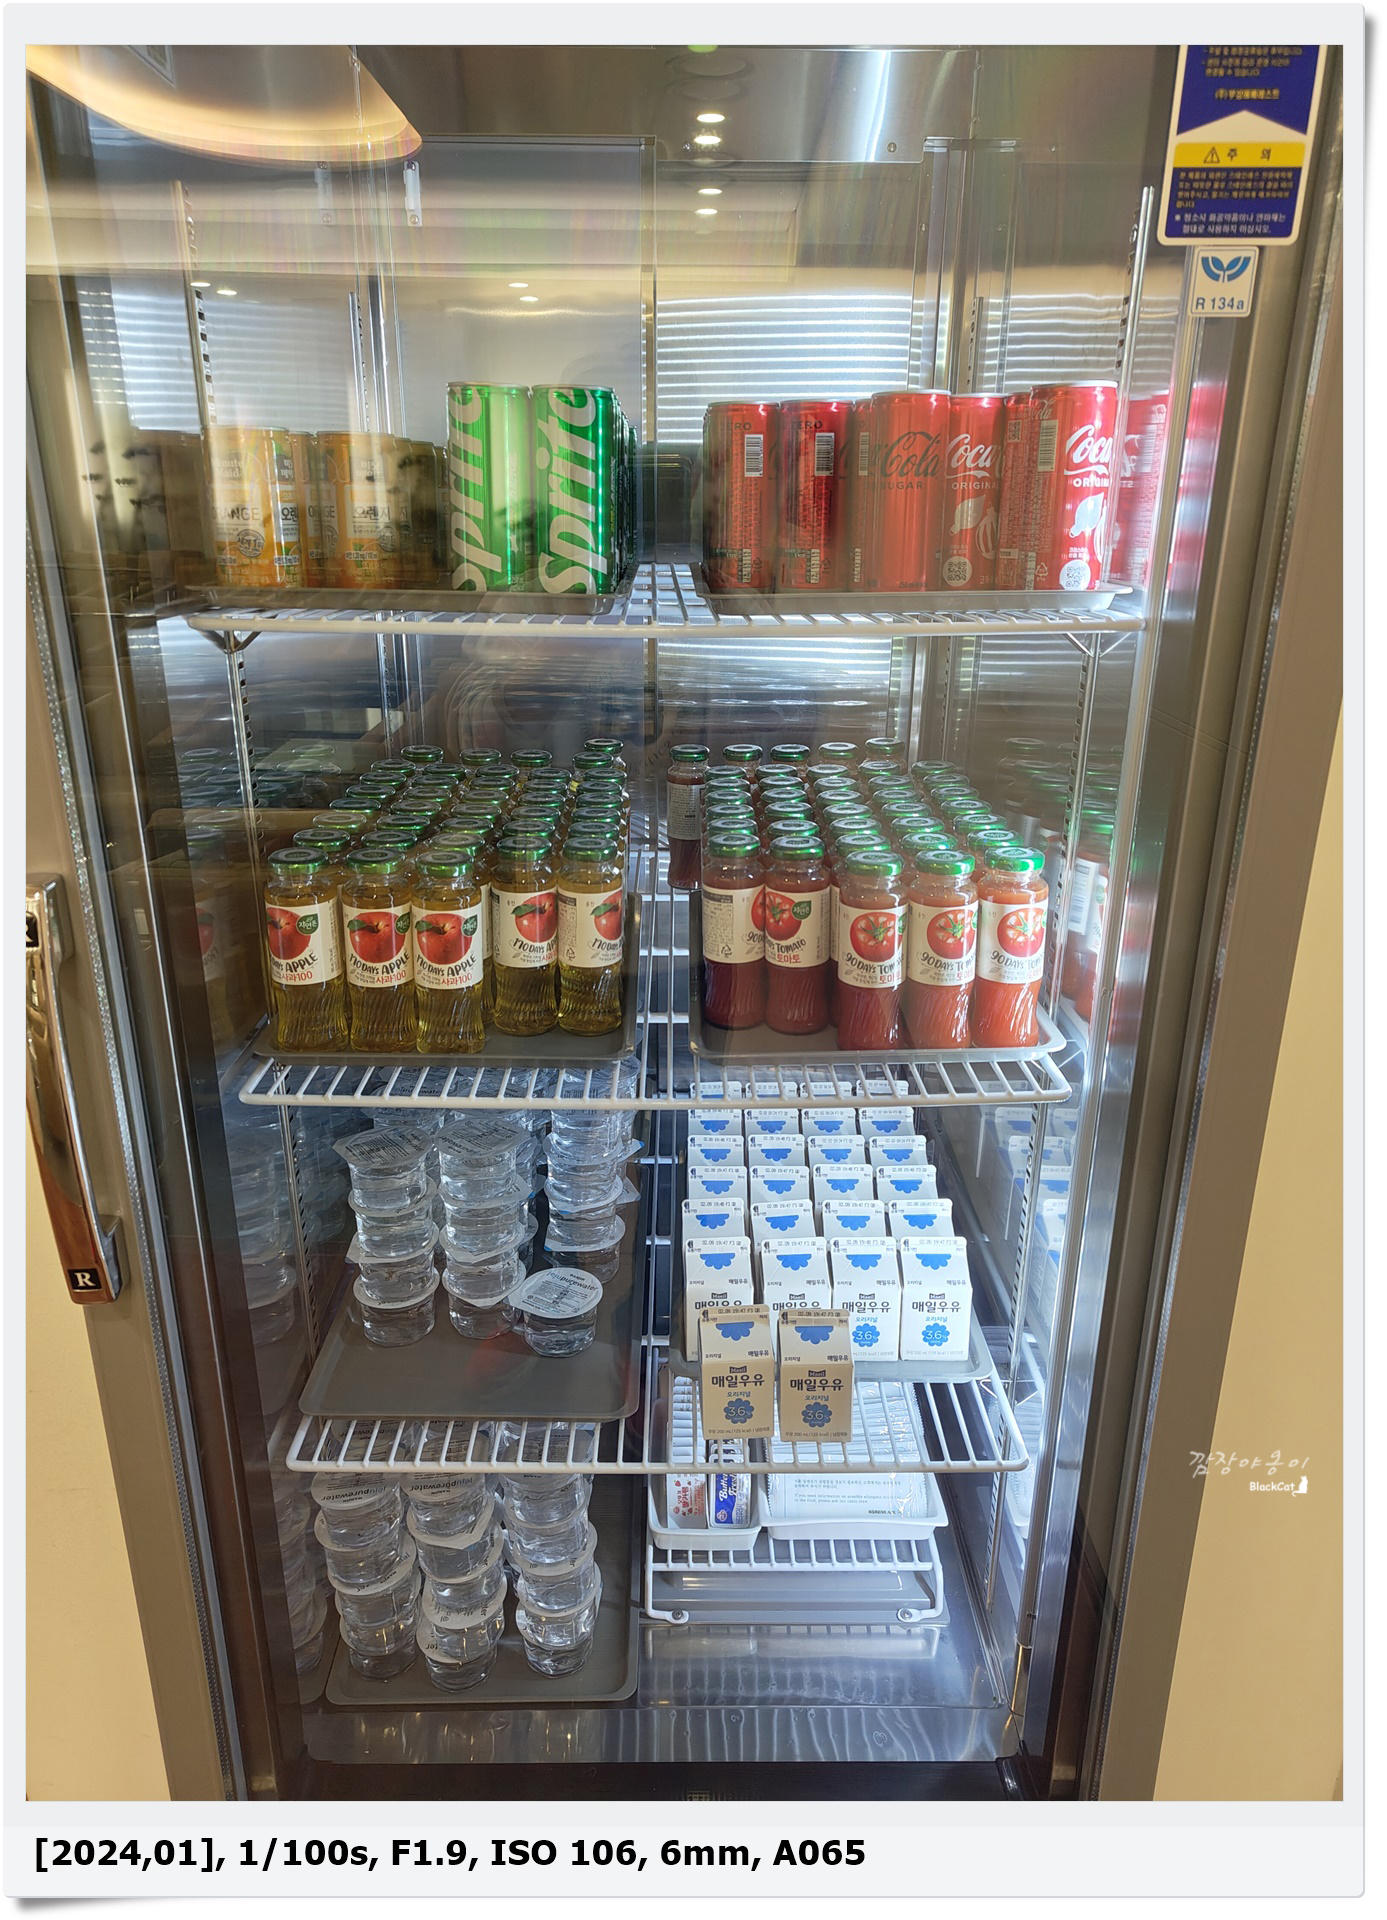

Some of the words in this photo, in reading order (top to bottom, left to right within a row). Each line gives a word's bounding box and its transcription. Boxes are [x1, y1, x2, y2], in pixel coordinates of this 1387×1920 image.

[1195, 298, 1205, 310] R
[1210, 298, 1244, 310] 134a
[536, 388, 608, 594] Sprite
[952, 482, 999, 490] ORIGINA
[352, 506, 391, 521] 오렌지
[793, 906, 810, 915] 자연은
[298, 920, 318, 930] 자연은
[776, 938, 807, 954] TOMATO
[286, 952, 318, 973] APPLE
[382, 950, 410, 975] APPLE
[446, 953, 477, 977] APPLE
[777, 954, 802, 964] 토마토
[282, 970, 312, 982] 사과100
[376, 970, 406, 985] 사과100
[442, 972, 472, 986] 사과100
[76, 1272, 94, 1287] R
[546, 1271, 598, 1292] jejupurewater
[842, 1302, 891, 1313] 매일우유
[912, 1301, 961, 1313] 매일우유
[712, 1374, 765, 1388] 매일우유
[790, 1378, 844, 1391] 매일우유
[321, 1485, 386, 1501] jejupurewater
